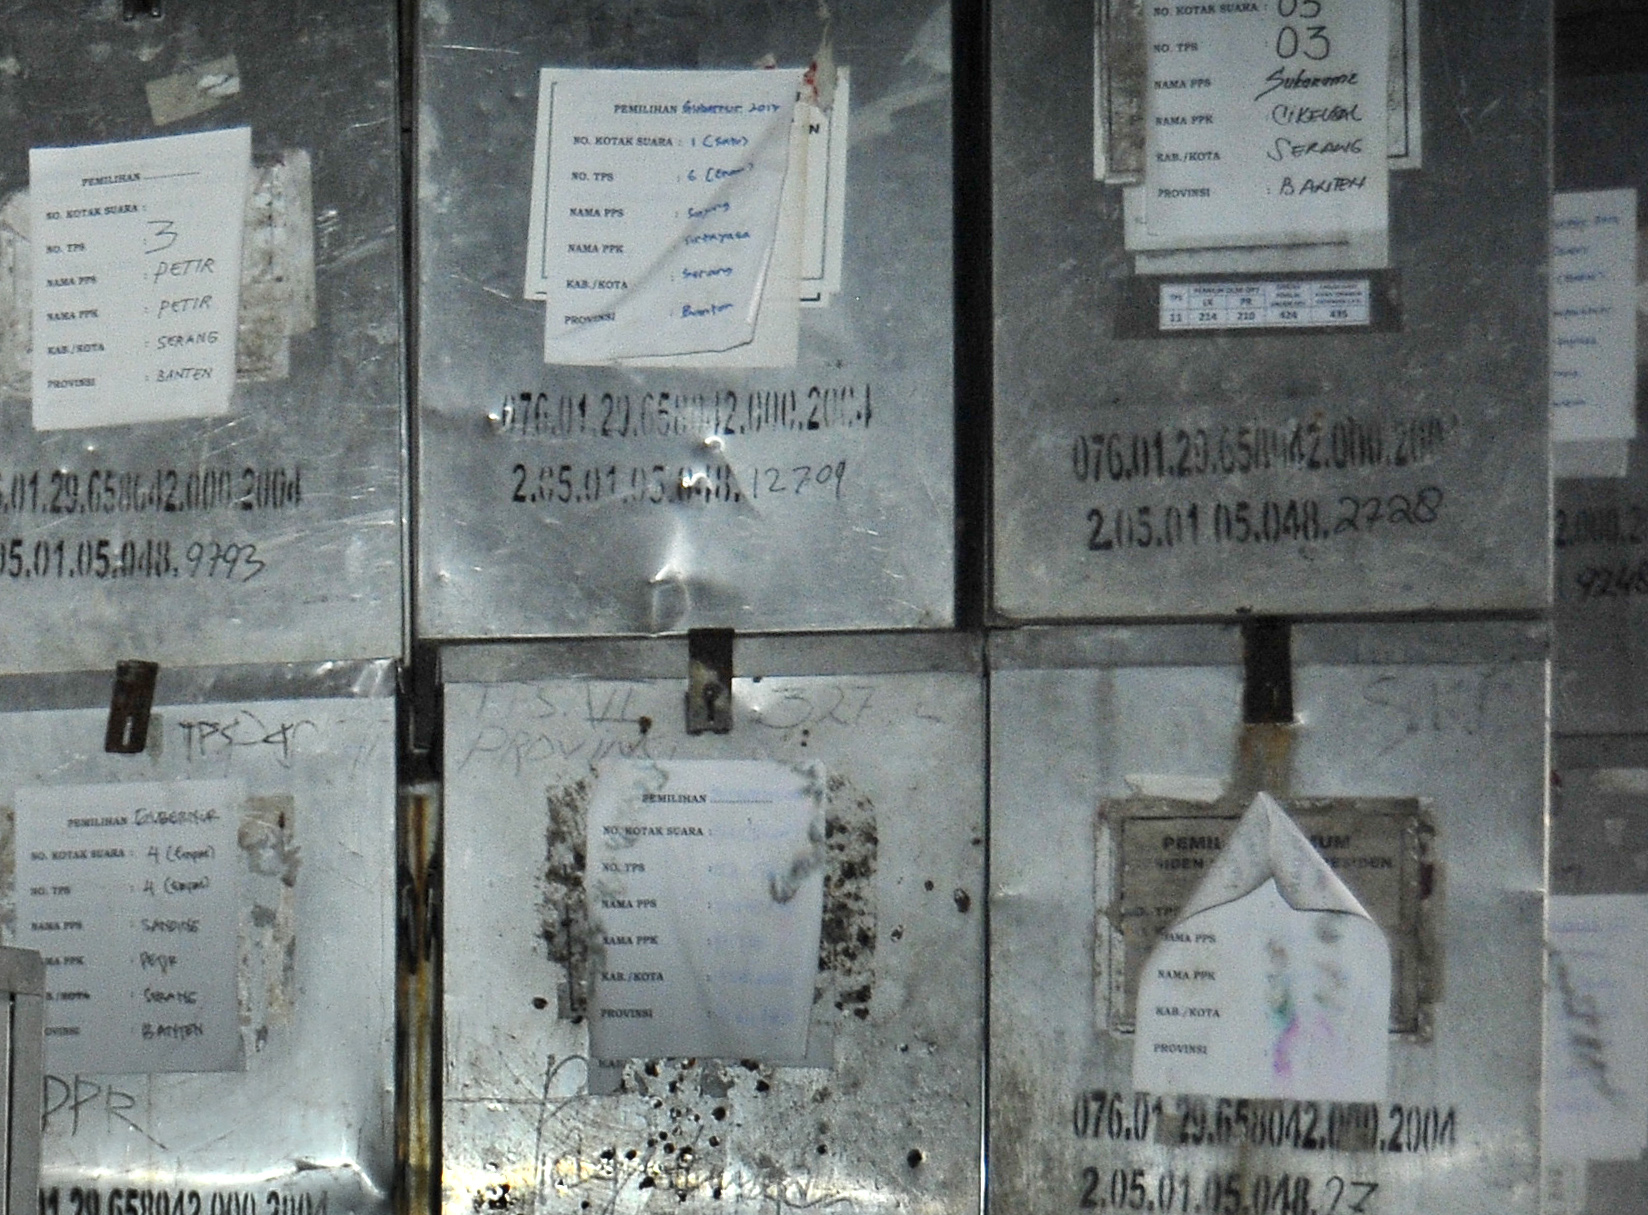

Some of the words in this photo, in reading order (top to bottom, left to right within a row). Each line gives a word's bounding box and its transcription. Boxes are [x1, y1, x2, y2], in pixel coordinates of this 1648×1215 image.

[1176, 5, 1217, 16] KOTAK
[1220, 3, 1259, 14] SUARA
[1177, 43, 1199, 52] TPS
[1276, 26, 1330, 60] 03
[1154, 80, 1187, 90] NAMA
[1190, 79, 1212, 88] PPS
[614, 104, 677, 114] PEMILIHAN
[1155, 116, 1187, 126] NAMA
[1191, 115, 1214, 125] PPK
[595, 137, 633, 147] KOTAK
[637, 137, 672, 147] SUARA
[81, 172, 140, 186] PEMILIHAN
[593, 172, 614, 181] TPS
[1158, 189, 1210, 198] PROVINSI
[66, 206, 101, 218] KOTAK
[104, 204, 138, 215] SUARA
[569, 208, 600, 217] NAMA
[604, 208, 624, 217] PPS
[67, 243, 85, 252] TPS
[145, 220, 178, 254] 3
[568, 244, 598, 253] NAMA
[602, 244, 624, 253] PPK
[46, 278, 75, 287] NAMA
[154, 258, 215, 284] PETIR
[46, 312, 75, 320] NAMA
[79, 309, 98, 318] PPK
[157, 295, 212, 318] PETIR
[564, 312, 615, 325] PROVINSI
[157, 331, 218, 349] SERANG
[47, 378, 95, 388] PROVINSI
[156, 367, 213, 383] BANTEN
[642, 794, 707, 804] PEMILIHAN
[68, 816, 128, 827] PEMILIHAN
[625, 826, 664, 836] KOTAK
[668, 826, 704, 836] SUARA
[624, 863, 645, 873] TPS
[601, 899, 633, 910] NAMA
[637, 899, 657, 910] PPS
[601, 935, 633, 946] NAMA
[636, 935, 658, 946] PPK
[1191, 932, 1216, 944] PPS
[1157, 970, 1190, 980] NAMA
[1192, 970, 1216, 981] PPK
[601, 1008, 653, 1019] PROVINSI
[1154, 1043, 1207, 1054] PROVINSI
